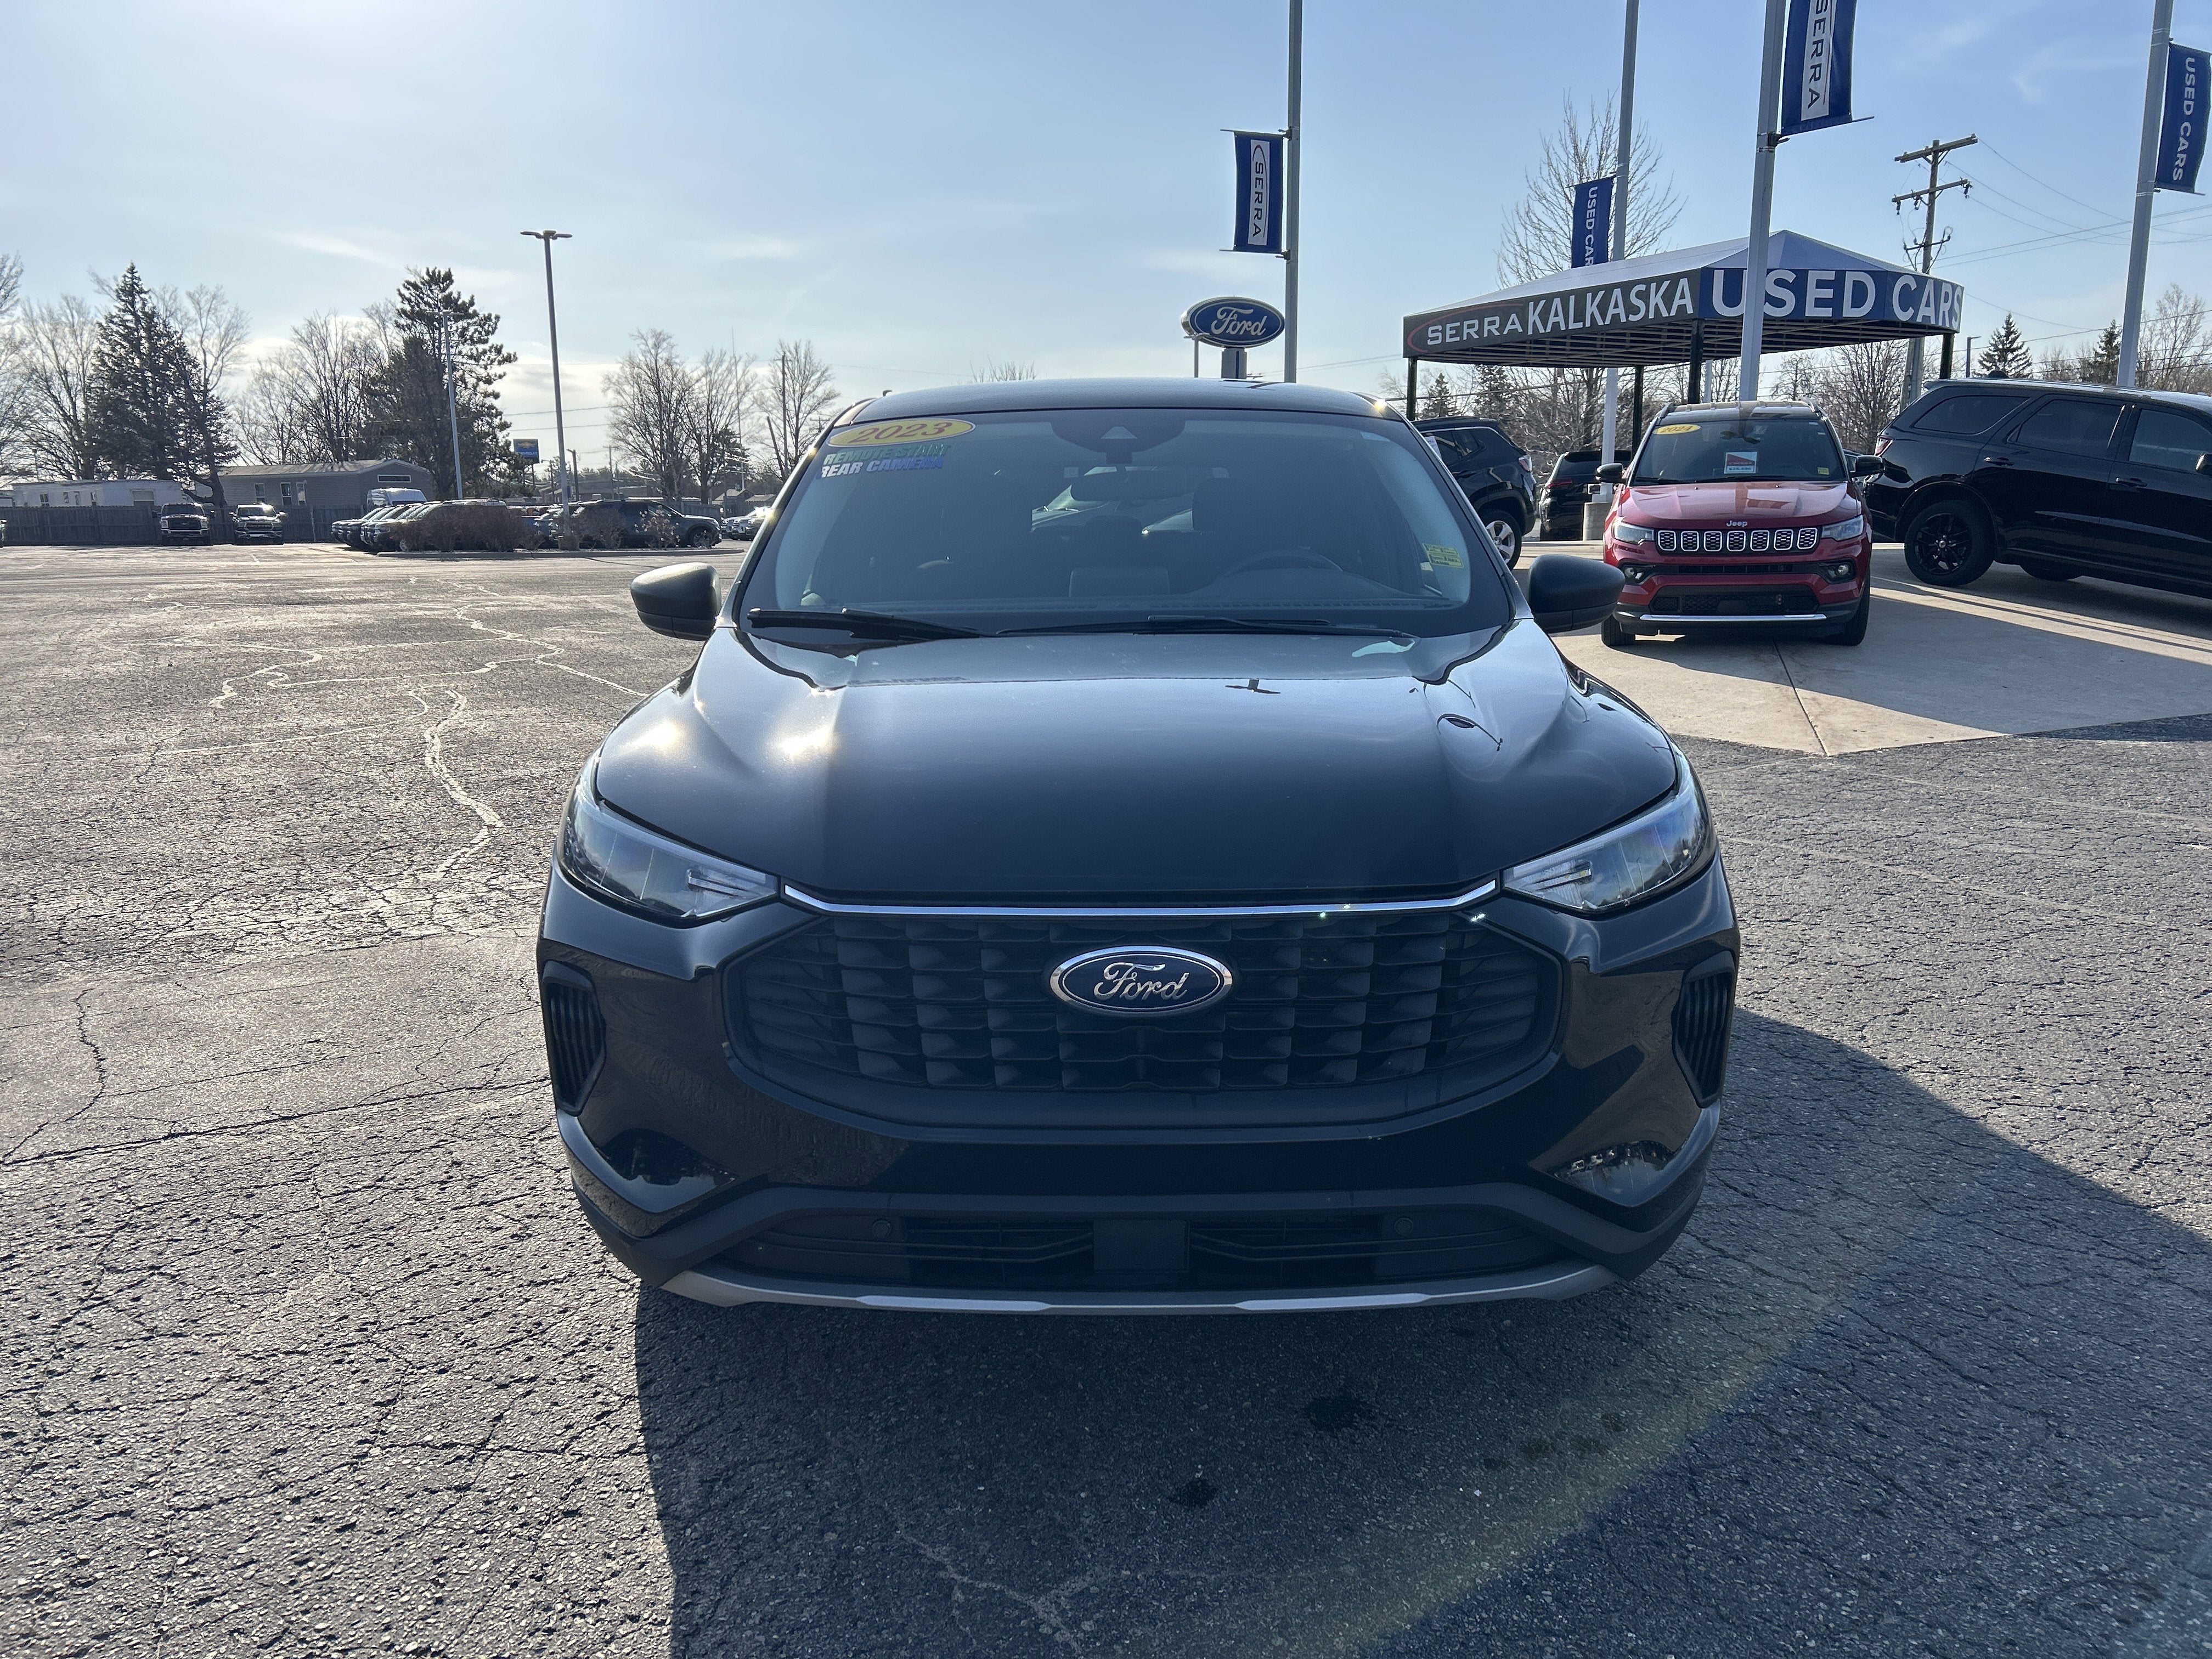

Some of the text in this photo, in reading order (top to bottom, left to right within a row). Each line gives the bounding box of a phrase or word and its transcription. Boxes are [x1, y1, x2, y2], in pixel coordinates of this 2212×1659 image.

[1808, 0, 1829, 109] SERRA
[2172, 57, 2195, 180] USED CARS
[1252, 161, 1264, 237] SERRA
[1585, 187, 1598, 266] USED CAR
[1211, 306, 1267, 336] Ford
[1427, 278, 1694, 345] SERRA KALKASKA
[1712, 269, 1963, 328] USED CARS
[823, 449, 894, 465] REMOTE
[849, 422, 953, 443] 2023
[816, 456, 945, 479] REAR CAMERA
[1093, 962, 1189, 1000] Ford
